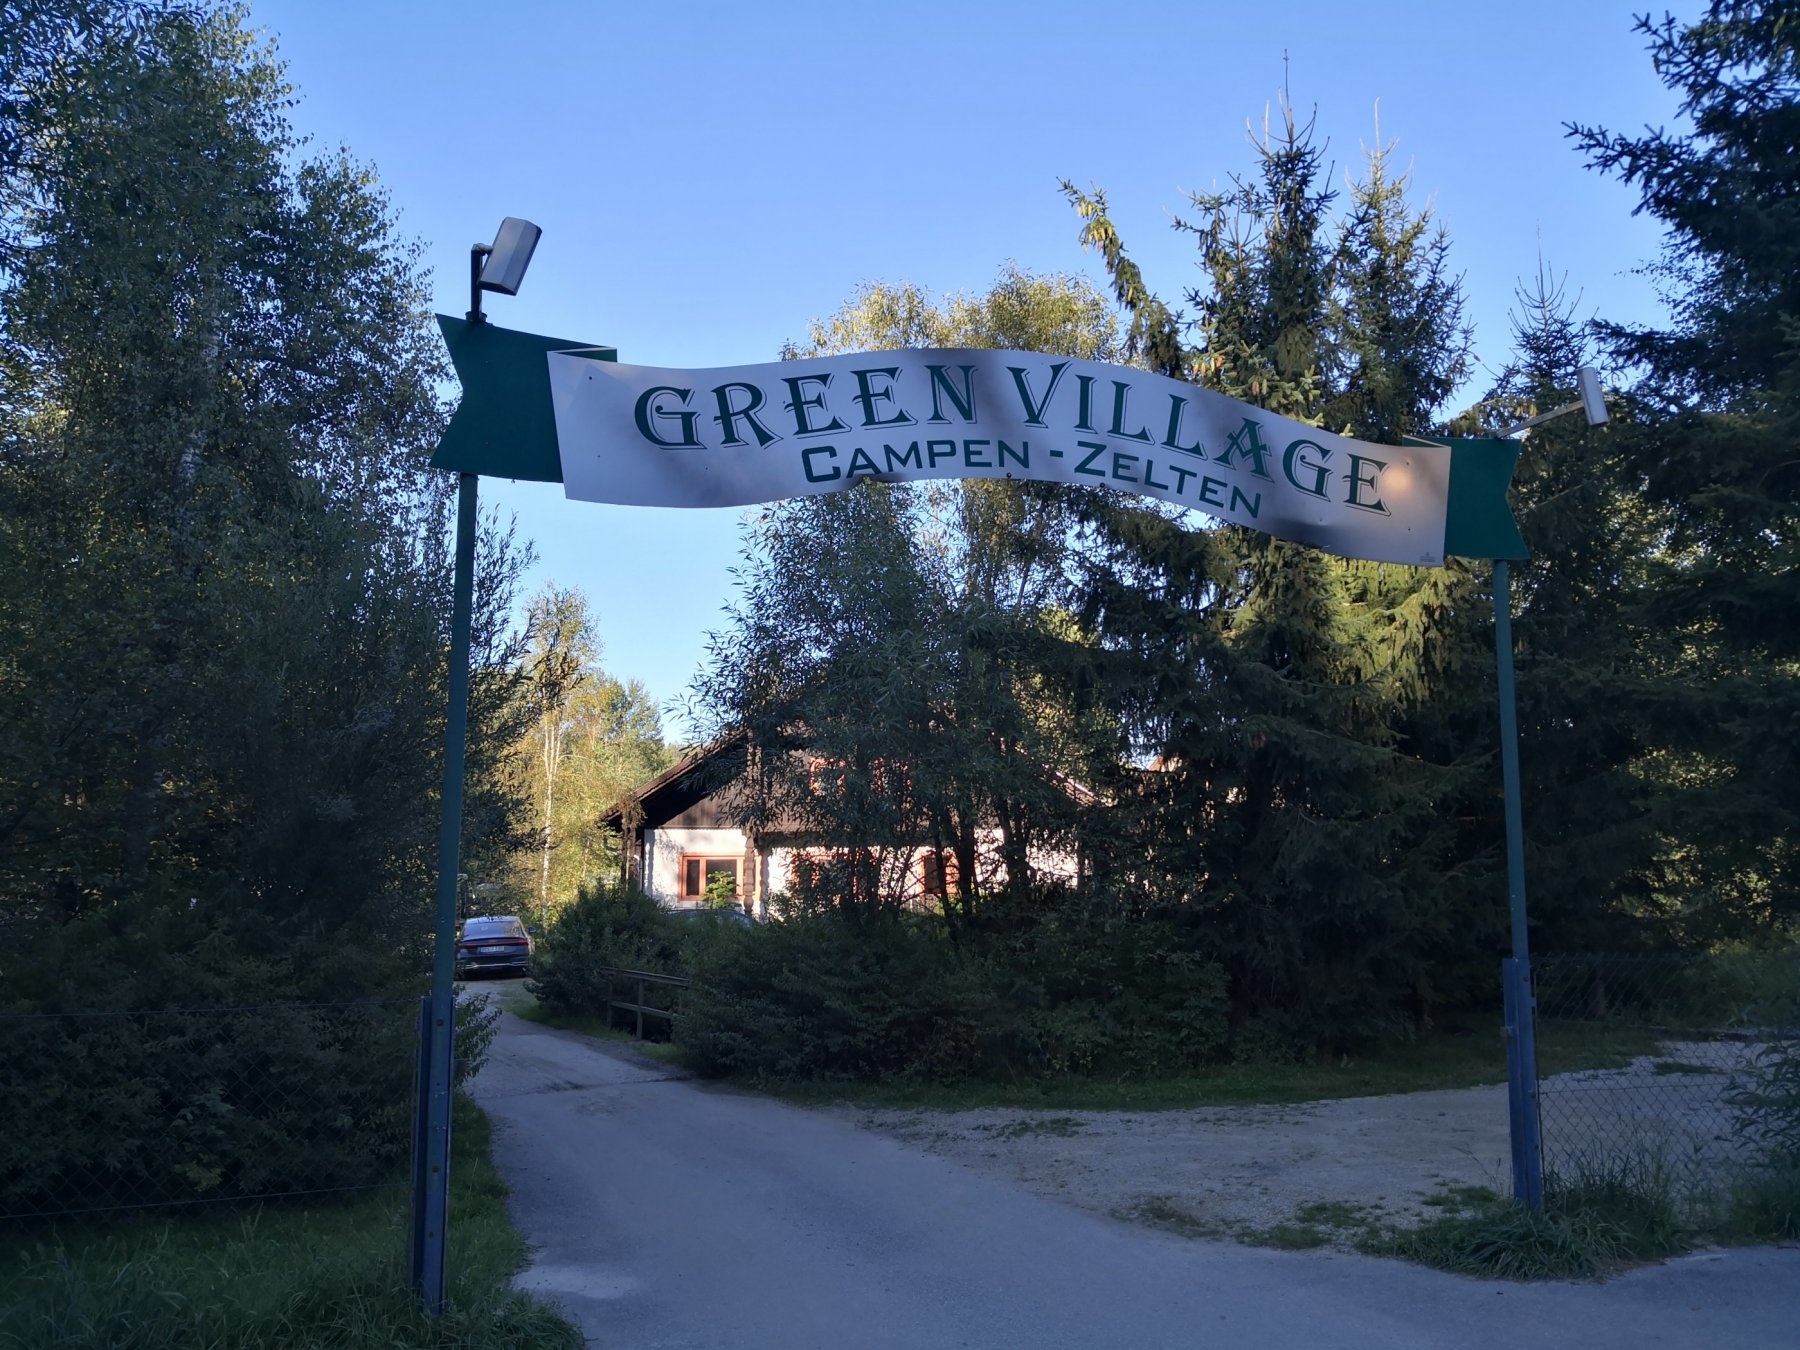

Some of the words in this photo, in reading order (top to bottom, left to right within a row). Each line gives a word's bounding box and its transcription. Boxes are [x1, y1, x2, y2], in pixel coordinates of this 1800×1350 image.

[634, 365, 977, 450] GREEN
[1007, 361, 1392, 516] VILLAGE
[801, 439, 1030, 483] CAMPEN
